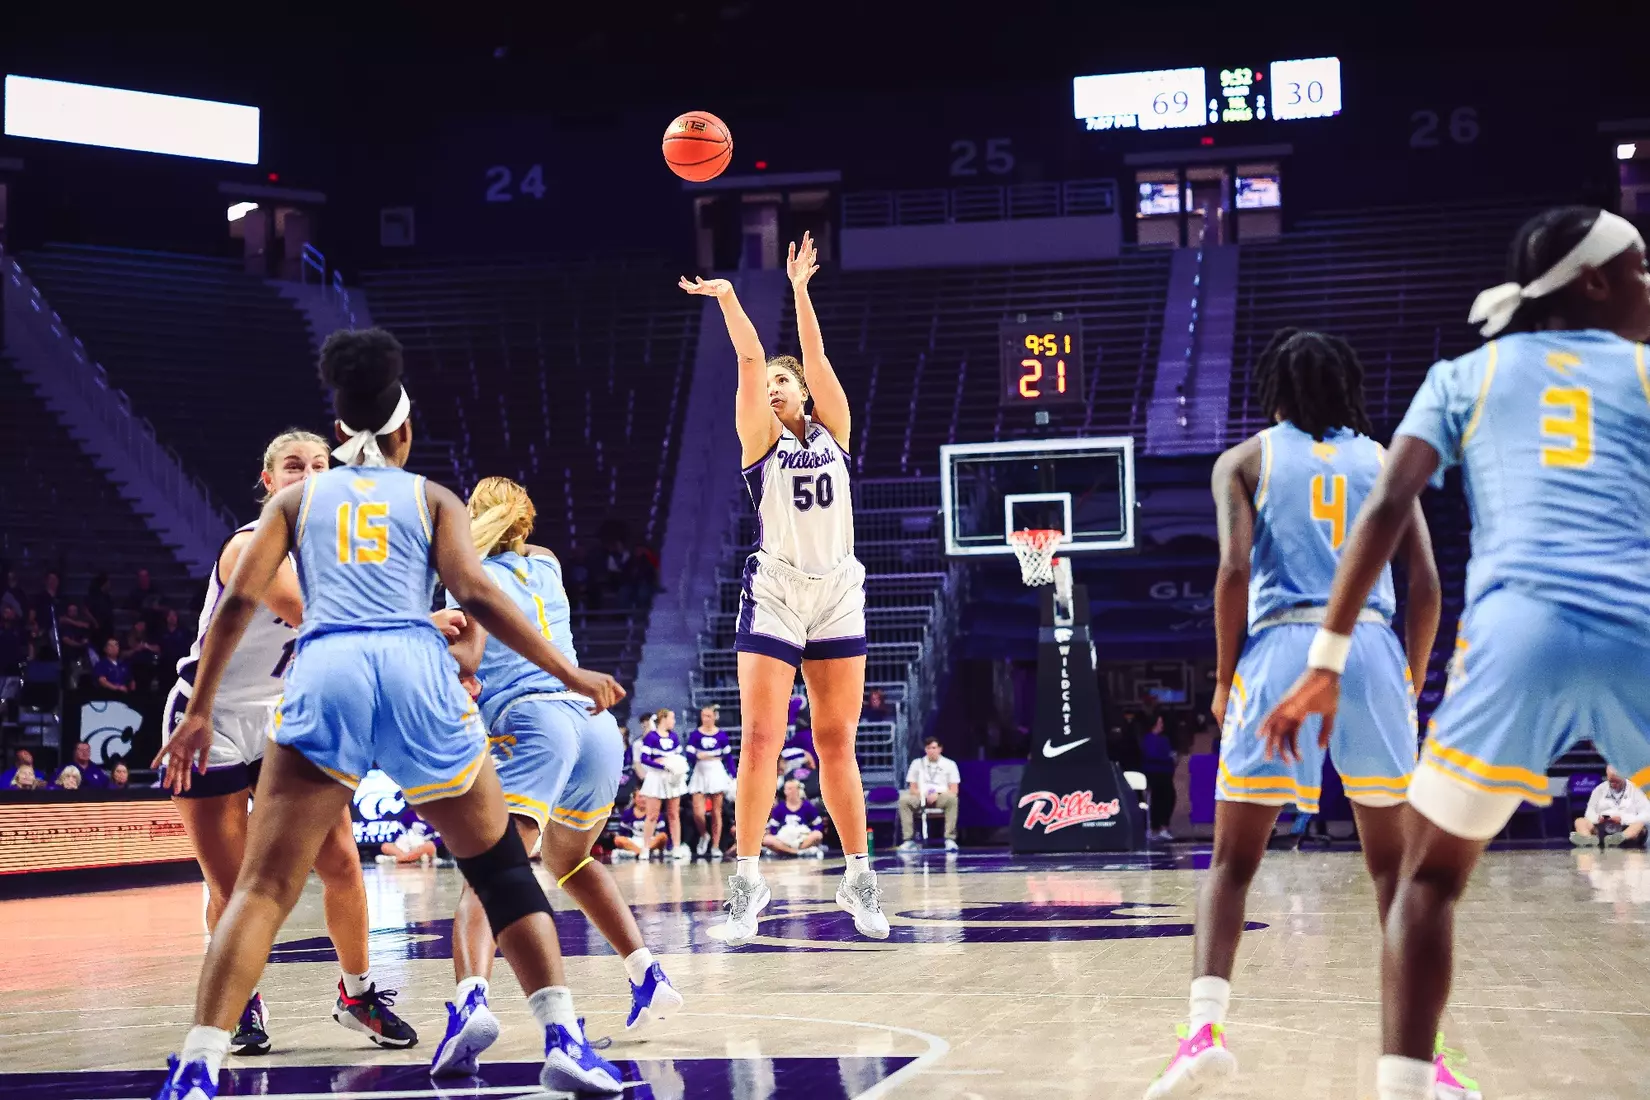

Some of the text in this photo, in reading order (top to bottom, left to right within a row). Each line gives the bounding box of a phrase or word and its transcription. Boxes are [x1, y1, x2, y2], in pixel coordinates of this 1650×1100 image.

[1153, 91, 1189, 115] 69
[1287, 81, 1324, 105] 30
[1409, 107, 1480, 149] 26
[949, 137, 1015, 176] 25
[484, 164, 548, 203] 24
[1025, 333, 1071, 356] 9:51
[1019, 359, 1066, 398] 21
[1541, 386, 1594, 468] 3
[792, 472, 834, 512] 50
[1310, 474, 1347, 548] 4
[335, 502, 389, 565] 15
[532, 593, 553, 641] 1
[1058, 645, 1071, 735] WILDCATS
[1018, 789, 1120, 832] Dillons
